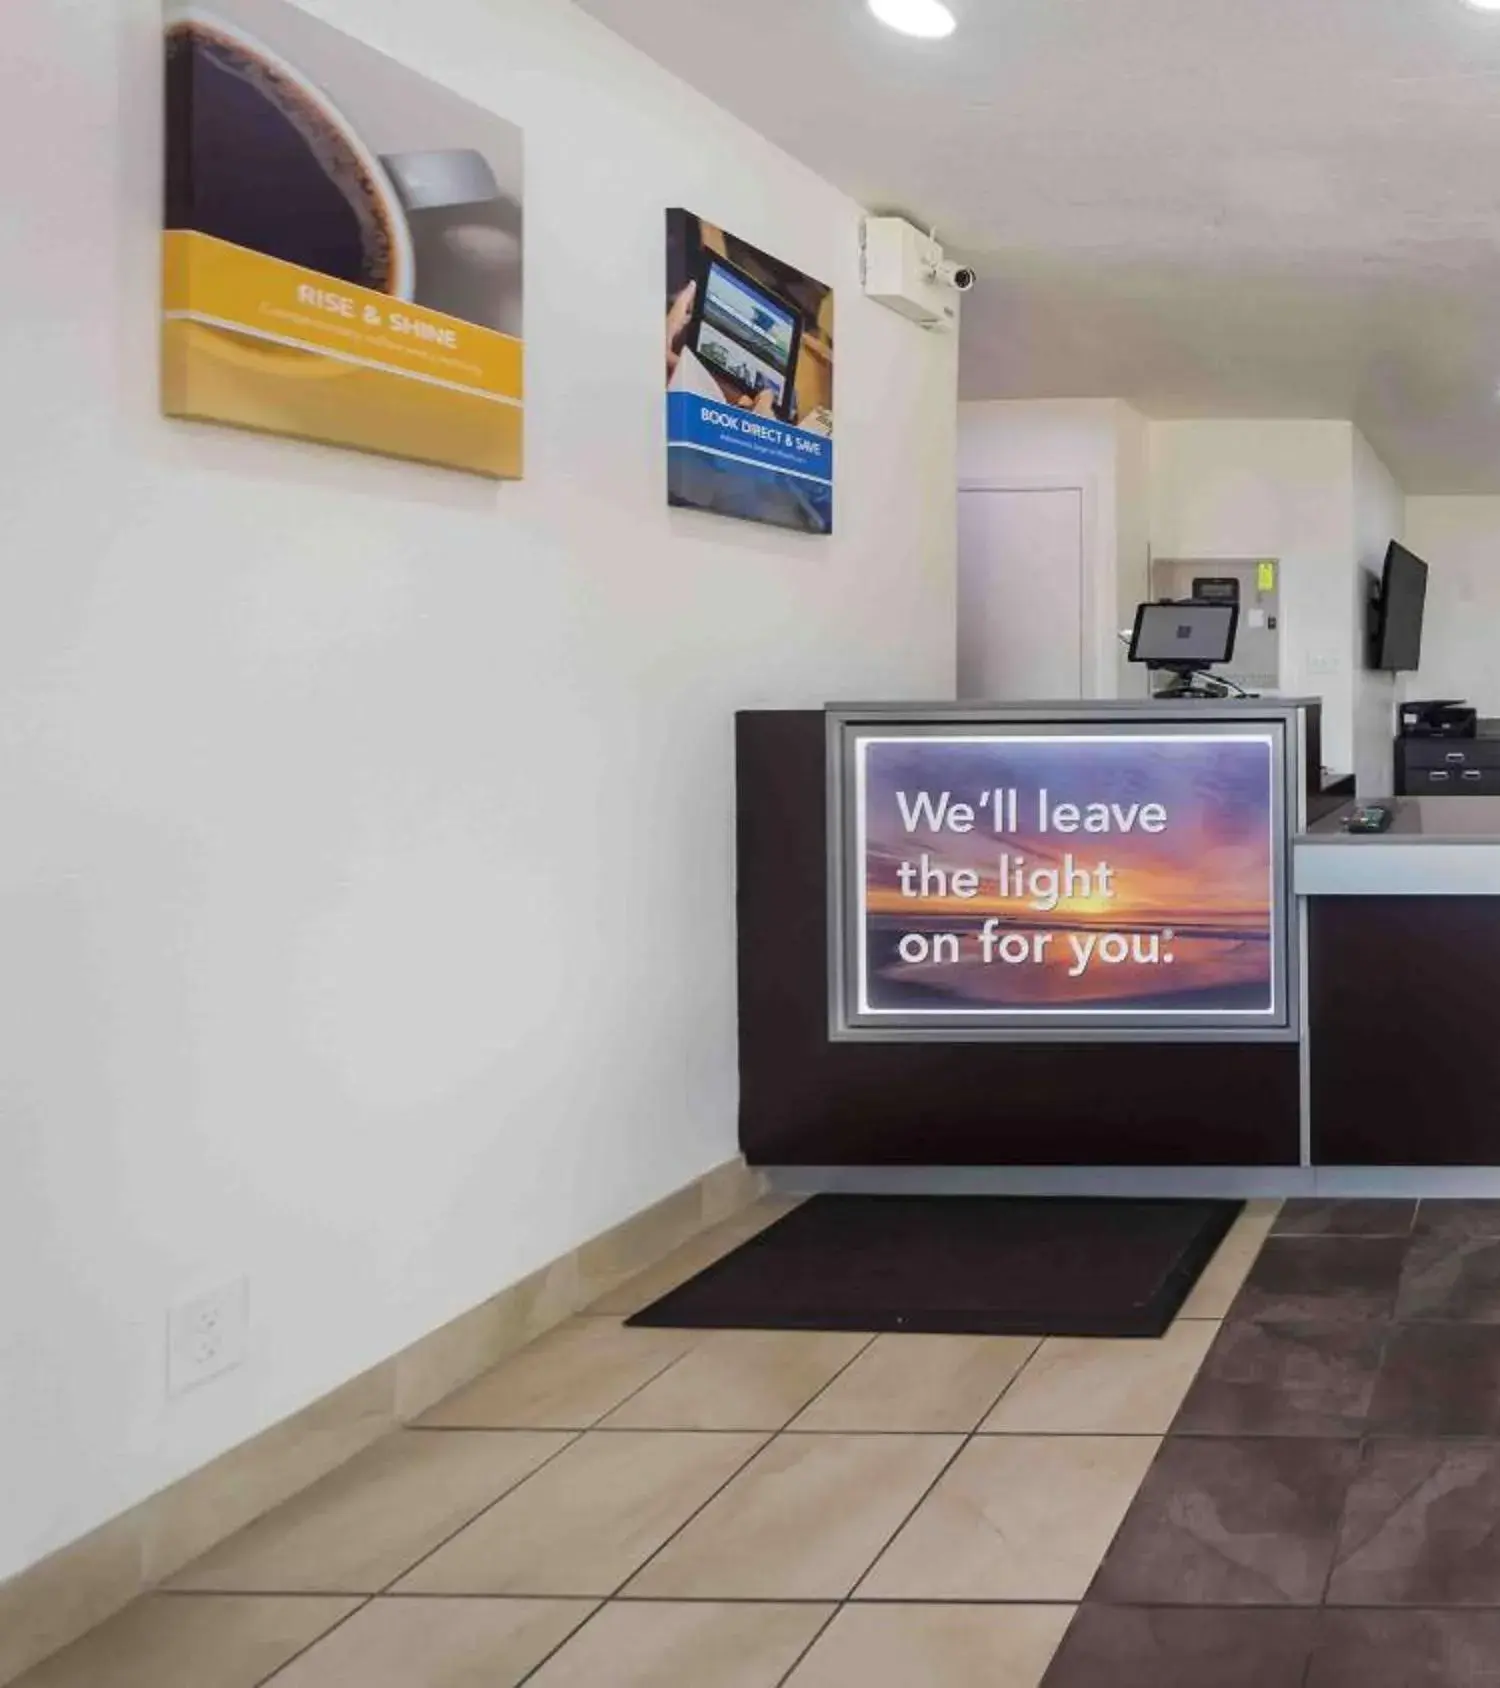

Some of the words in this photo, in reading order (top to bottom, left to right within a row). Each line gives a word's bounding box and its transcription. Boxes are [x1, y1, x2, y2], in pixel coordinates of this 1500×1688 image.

[297, 284, 357, 319] RISE
[363, 304, 381, 326] &
[389, 313, 458, 349] SHINE
[701, 407, 739, 431] BOOK
[741, 420, 782, 443] DIRECT
[785, 434, 793, 447] &
[796, 438, 821, 456] SAVE
[896, 788, 1017, 833] We'll
[1039, 788, 1168, 833] leave
[896, 854, 980, 898] the
[1000, 853, 1114, 911] light
[898, 932, 960, 963] on
[979, 917, 1053, 963] for
